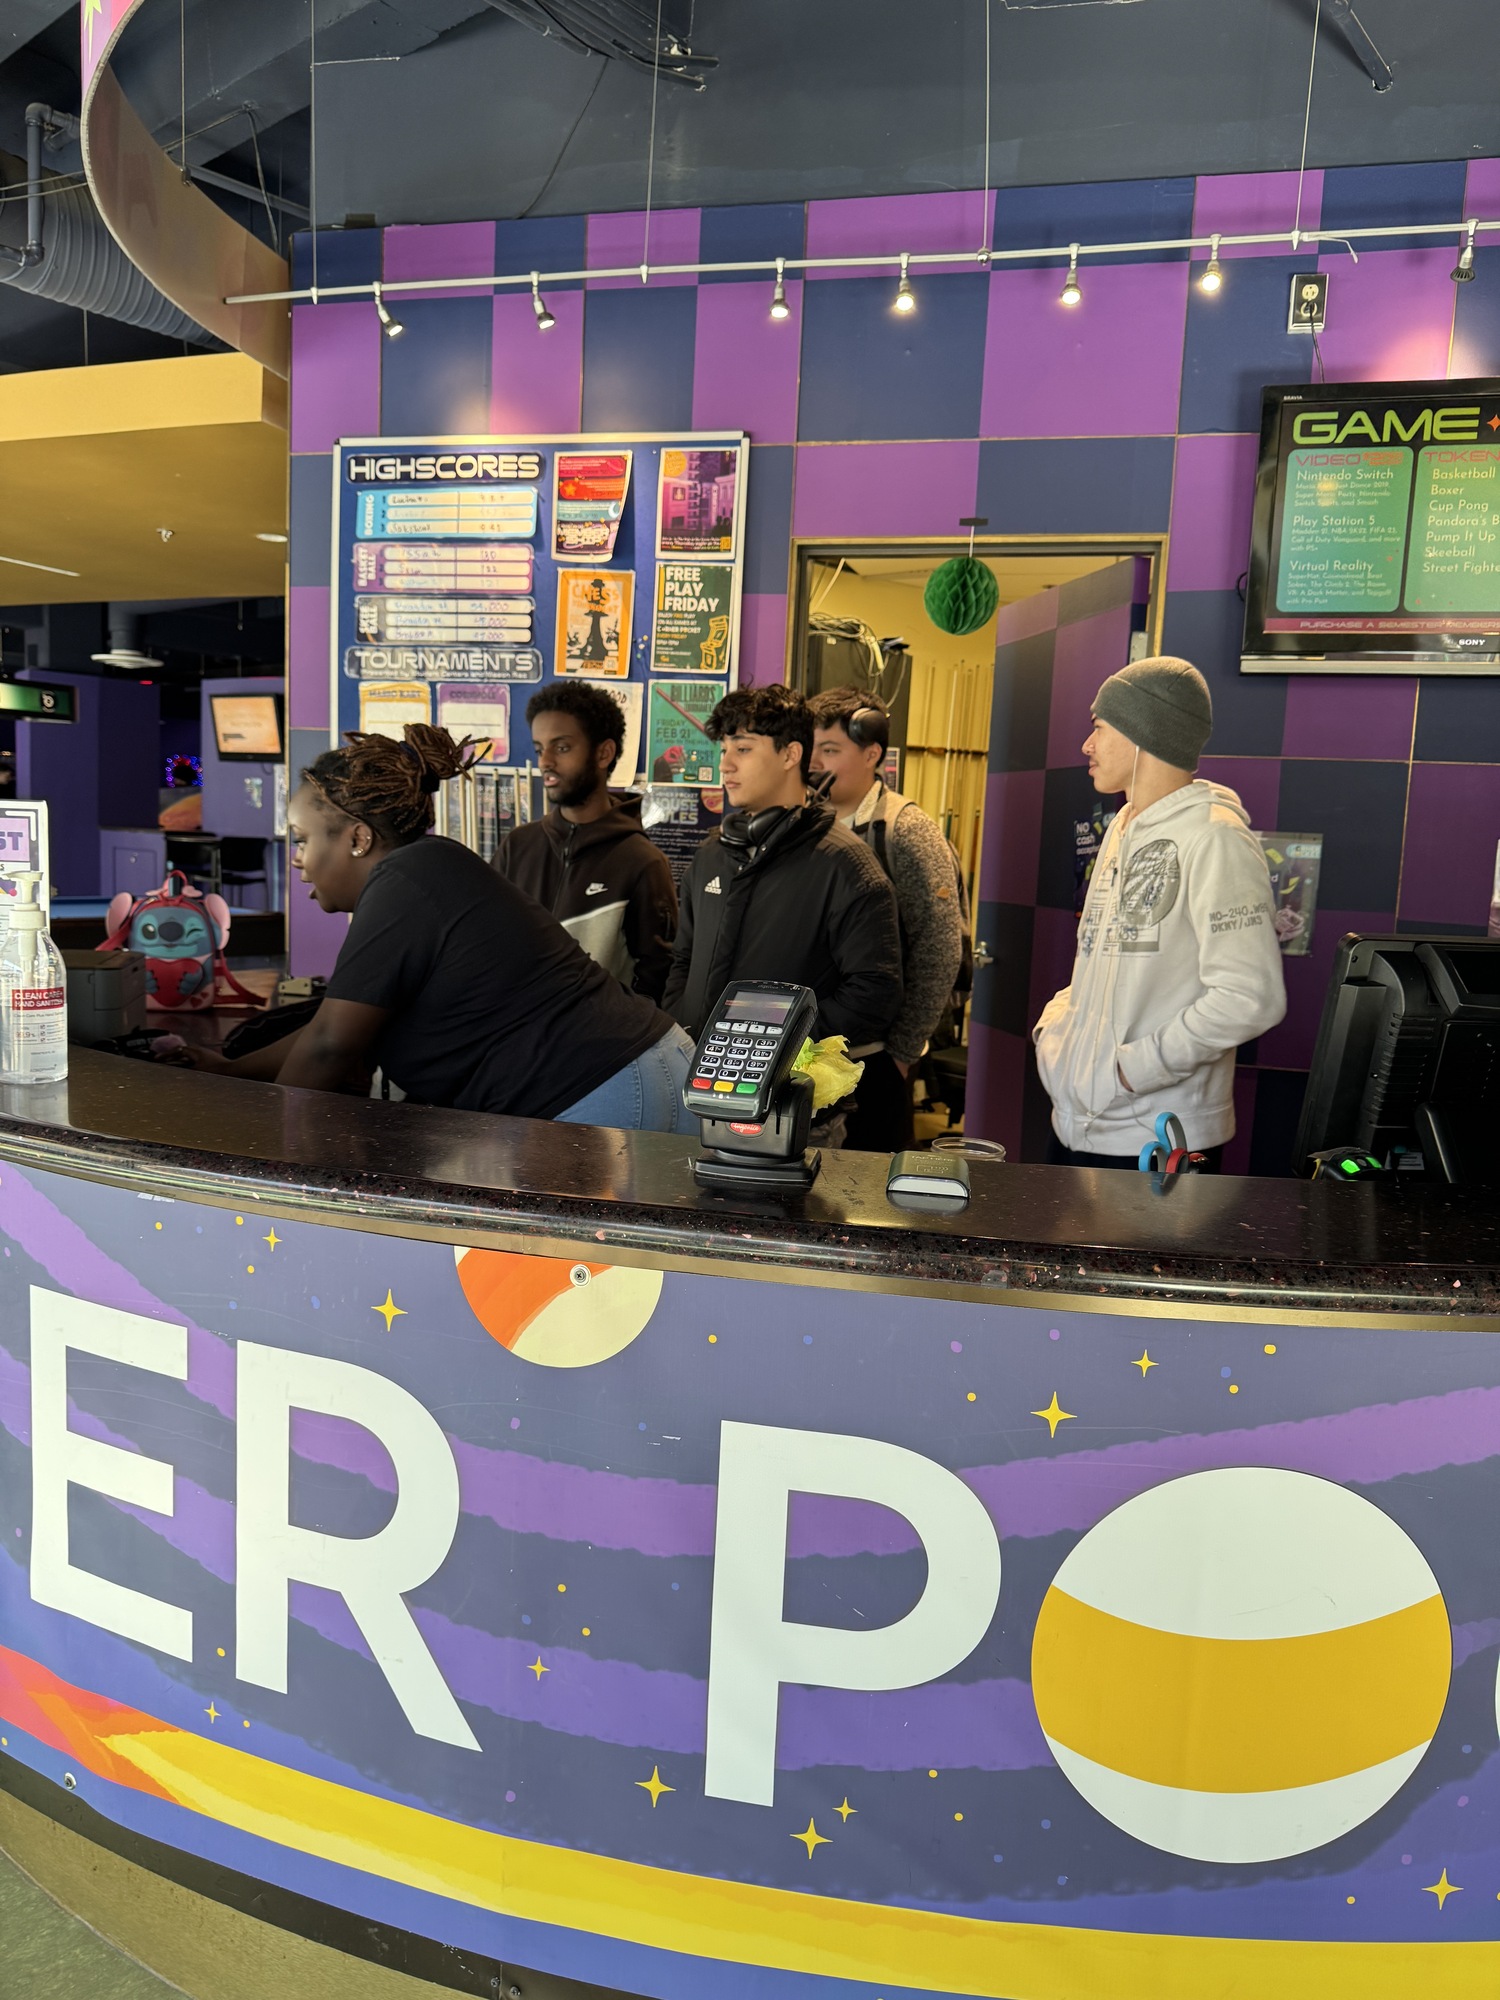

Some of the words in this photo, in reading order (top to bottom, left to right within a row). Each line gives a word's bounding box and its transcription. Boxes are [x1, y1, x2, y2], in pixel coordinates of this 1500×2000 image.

[1293, 407, 1481, 445] GAME
[1295, 453, 1361, 467] VIDEO
[350, 454, 540, 481] HIGHSCORES
[1297, 468, 1352, 480] Nintendo
[1356, 468, 1394, 480] Switch
[1432, 466, 1496, 480] Basketball
[1431, 484, 1464, 495] Boxer
[1429, 500, 1453, 512] Cup
[1458, 499, 1489, 512] Pong
[1293, 515, 1318, 528] Play
[1323, 515, 1364, 526] Station
[1369, 515, 1375, 526] 5
[1428, 515, 1487, 526] Pandora's
[1426, 531, 1460, 543] Pump
[1465, 530, 1473, 541] It
[1478, 530, 1496, 543] Up
[1425, 545, 1476, 557] Skeeball
[1290, 560, 1329, 571] Virtual
[1333, 560, 1374, 573] Reality
[1423, 562, 1458, 573] Street
[665, 566, 701, 581] FREE
[665, 582, 704, 596] PLAY
[664, 597, 719, 612] FRIDAY
[355, 651, 533, 671] TOURNAMENTS
[656, 728, 677, 738] FEB
[1076, 822, 1090, 834] NO
[1076, 833, 1095, 846] cash
[14, 992, 42, 1000] CLEAN
[30, 1284, 483, 1752] ER
